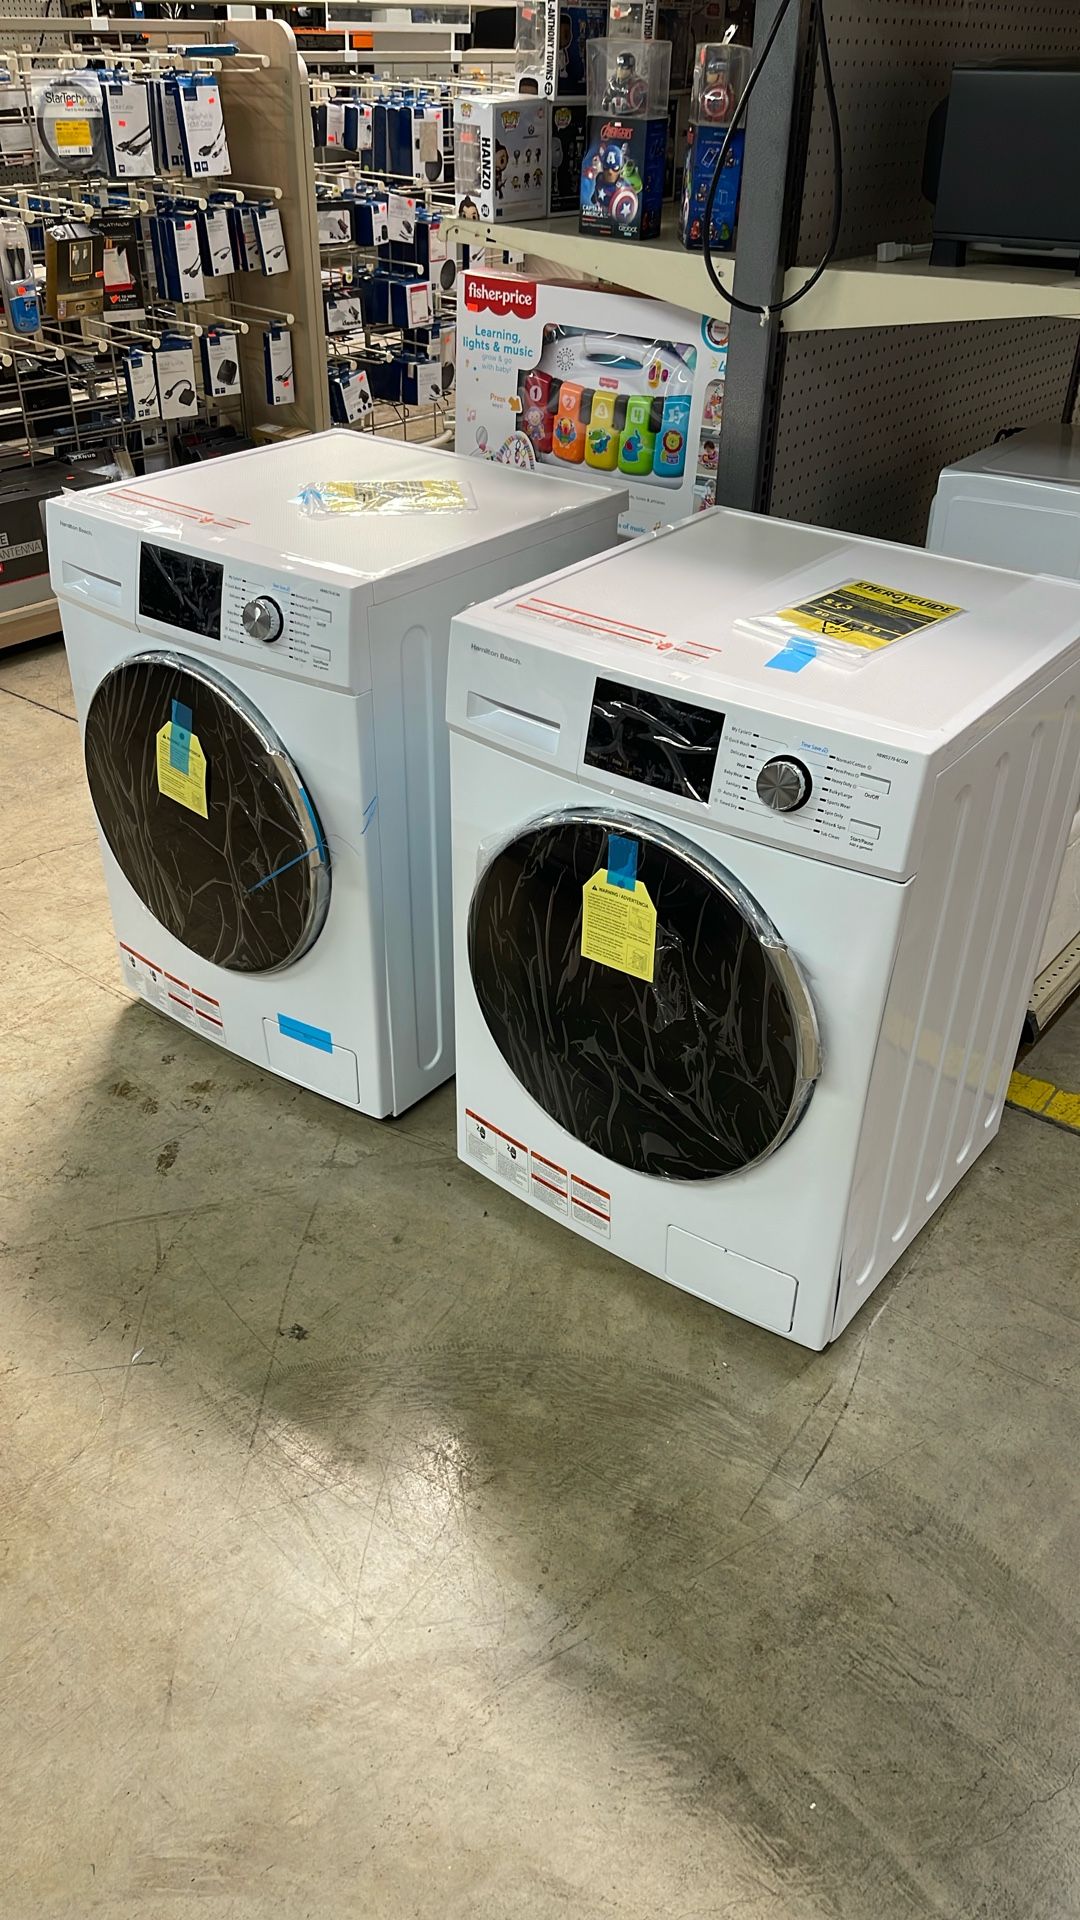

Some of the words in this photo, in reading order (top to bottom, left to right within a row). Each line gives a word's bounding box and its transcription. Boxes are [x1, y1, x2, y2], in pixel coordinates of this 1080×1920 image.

[545, 50, 554, 81] TOWNS
[481, 137, 491, 190] HANZO
[468, 282, 532, 306] fisher-price
[475, 325, 521, 344] Learning,
[463, 336, 490, 351] lights
[493, 341, 500, 352] &
[503, 343, 533, 357] music
[471, 643, 499, 658] Hamilton
[500, 653, 521, 665] Beach
[599, 887, 619, 898] WARNING
